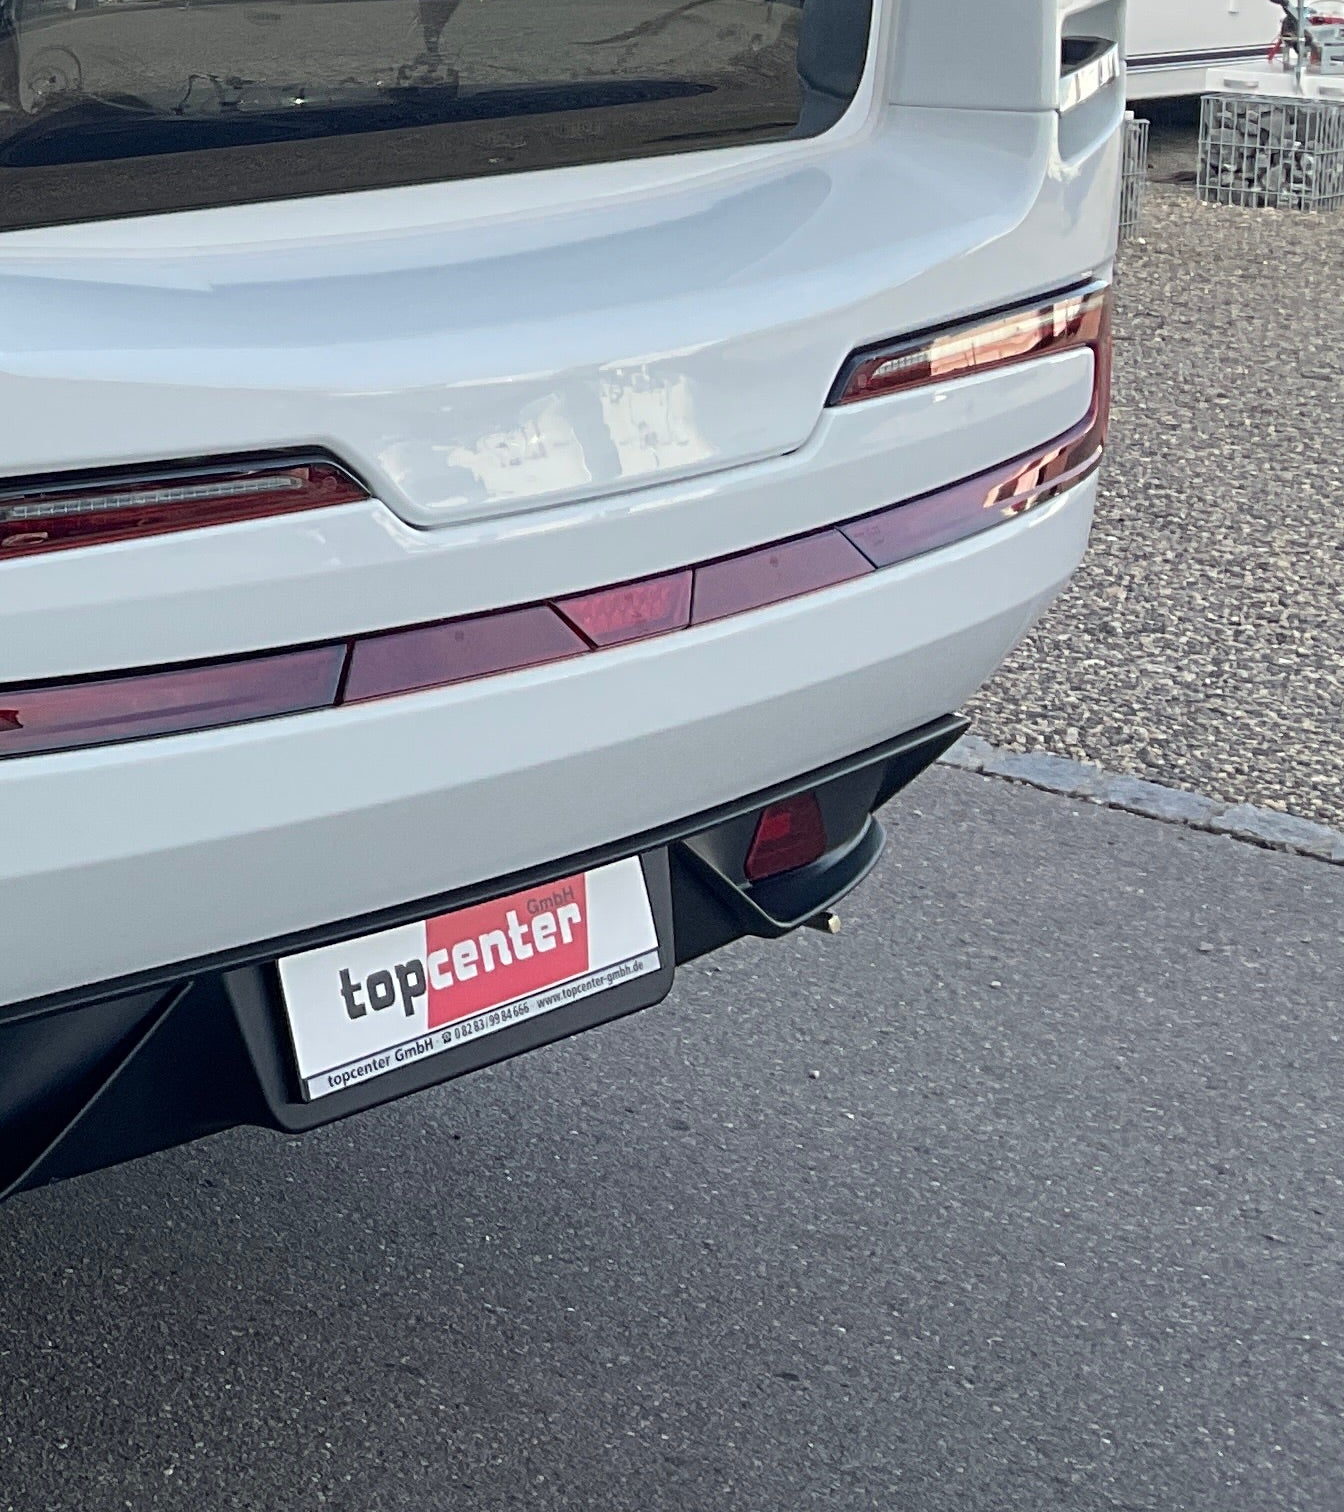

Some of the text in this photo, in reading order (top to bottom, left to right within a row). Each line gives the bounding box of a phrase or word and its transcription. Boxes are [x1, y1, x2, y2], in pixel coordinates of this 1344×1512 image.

[526, 885, 575, 915] GmbH
[339, 901, 582, 1021] topcenter
[327, 1055, 391, 1088] topcenter
[394, 1037, 434, 1062] GmbH
[536, 959, 644, 1010] www.topcenter-gmbh.de
